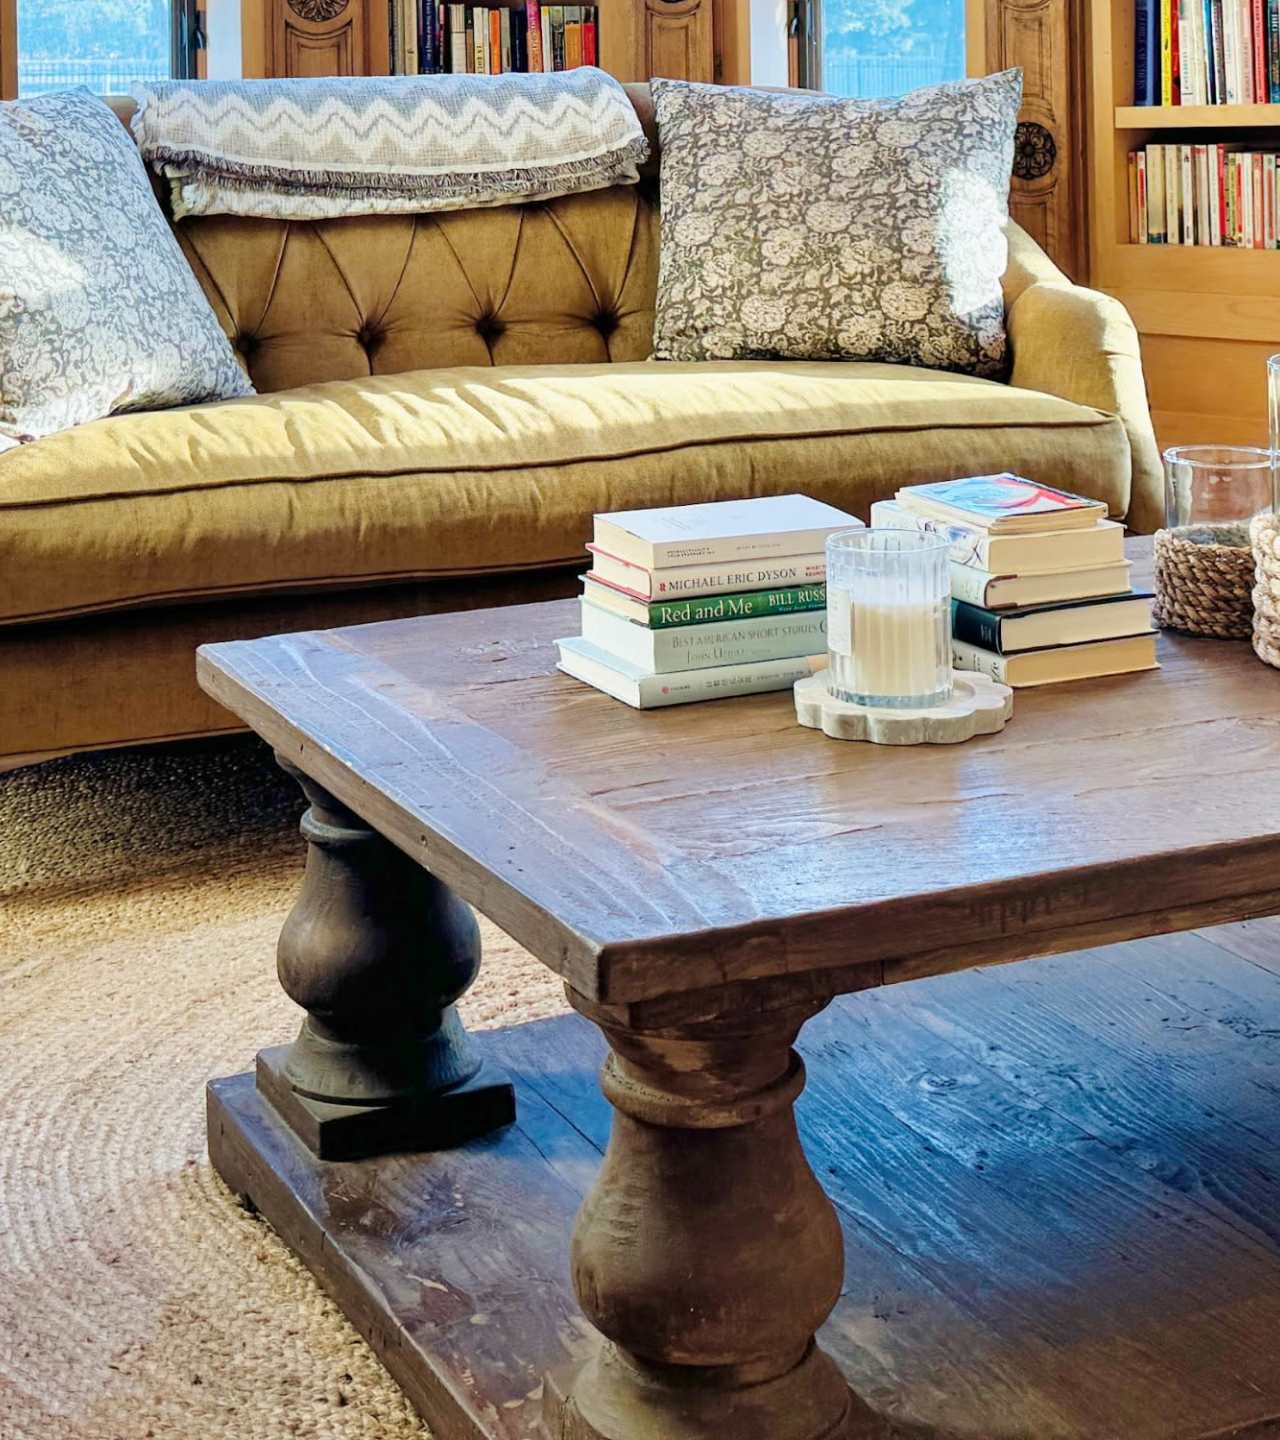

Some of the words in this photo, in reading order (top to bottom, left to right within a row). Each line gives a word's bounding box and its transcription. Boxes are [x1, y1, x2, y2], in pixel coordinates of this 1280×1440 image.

[668, 575, 723, 591] MICHAEL
[727, 573, 753, 585] ERIC
[758, 568, 797, 581] DYSON
[768, 593, 795, 607] BILL
[798, 590, 826, 603] RUSS
[661, 605, 690, 624] Red
[695, 602, 724, 619] and
[728, 599, 753, 616] Me
[672, 635, 694, 648] BEST
[695, 631, 747, 646] AMERICAN
[748, 628, 779, 640] SHORT
[782, 623, 817, 635] STORIES
